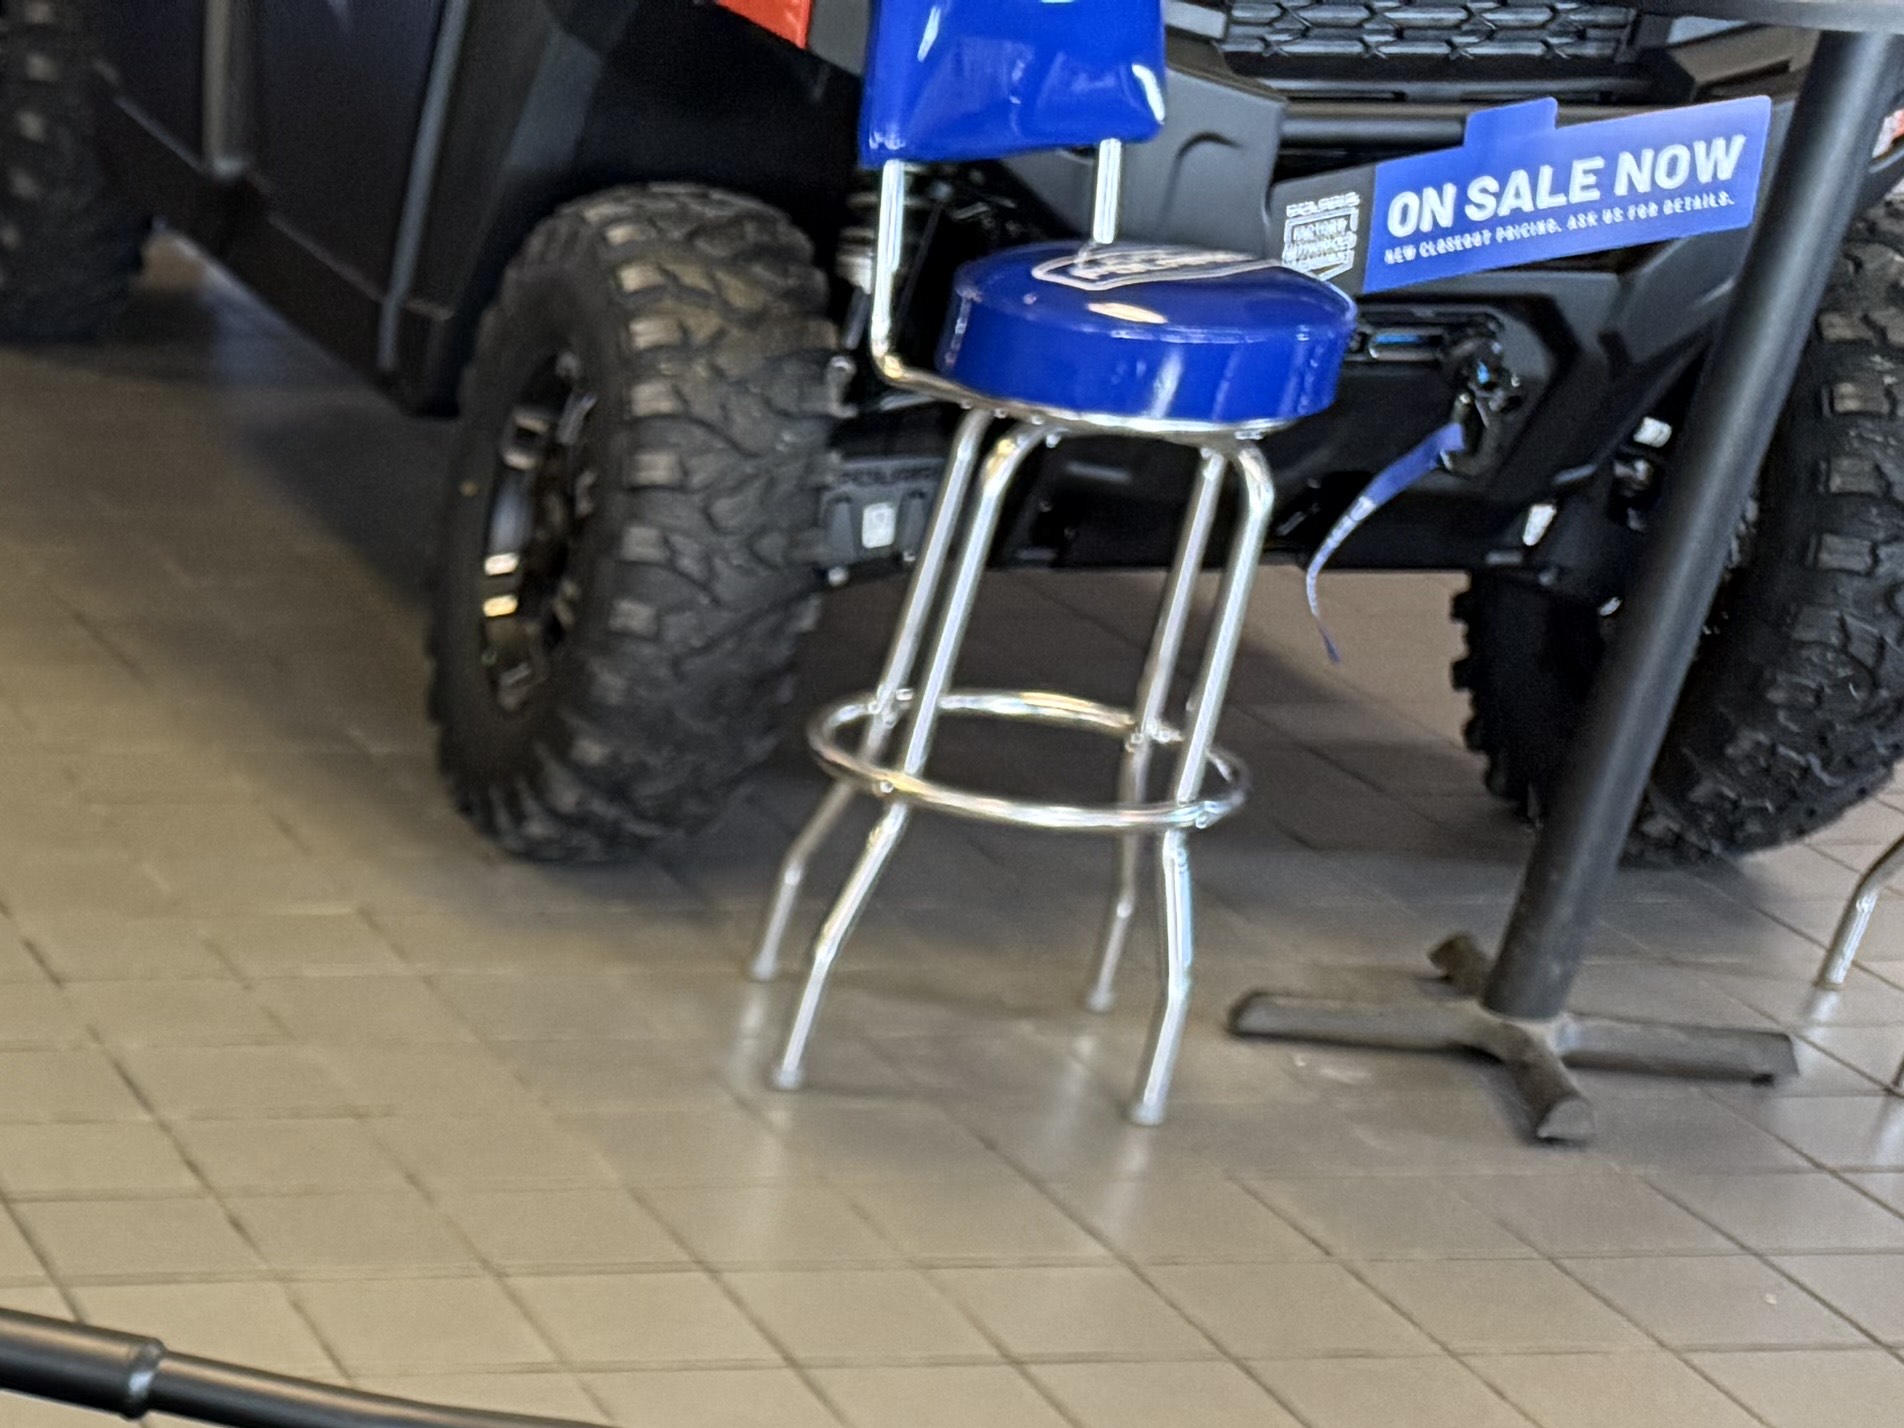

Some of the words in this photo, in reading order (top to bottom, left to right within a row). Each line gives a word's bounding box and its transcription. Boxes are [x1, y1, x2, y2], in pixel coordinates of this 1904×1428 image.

[1385, 180, 1457, 239] ON
[1464, 155, 1605, 224] SALE
[1613, 133, 1748, 198] NOW
